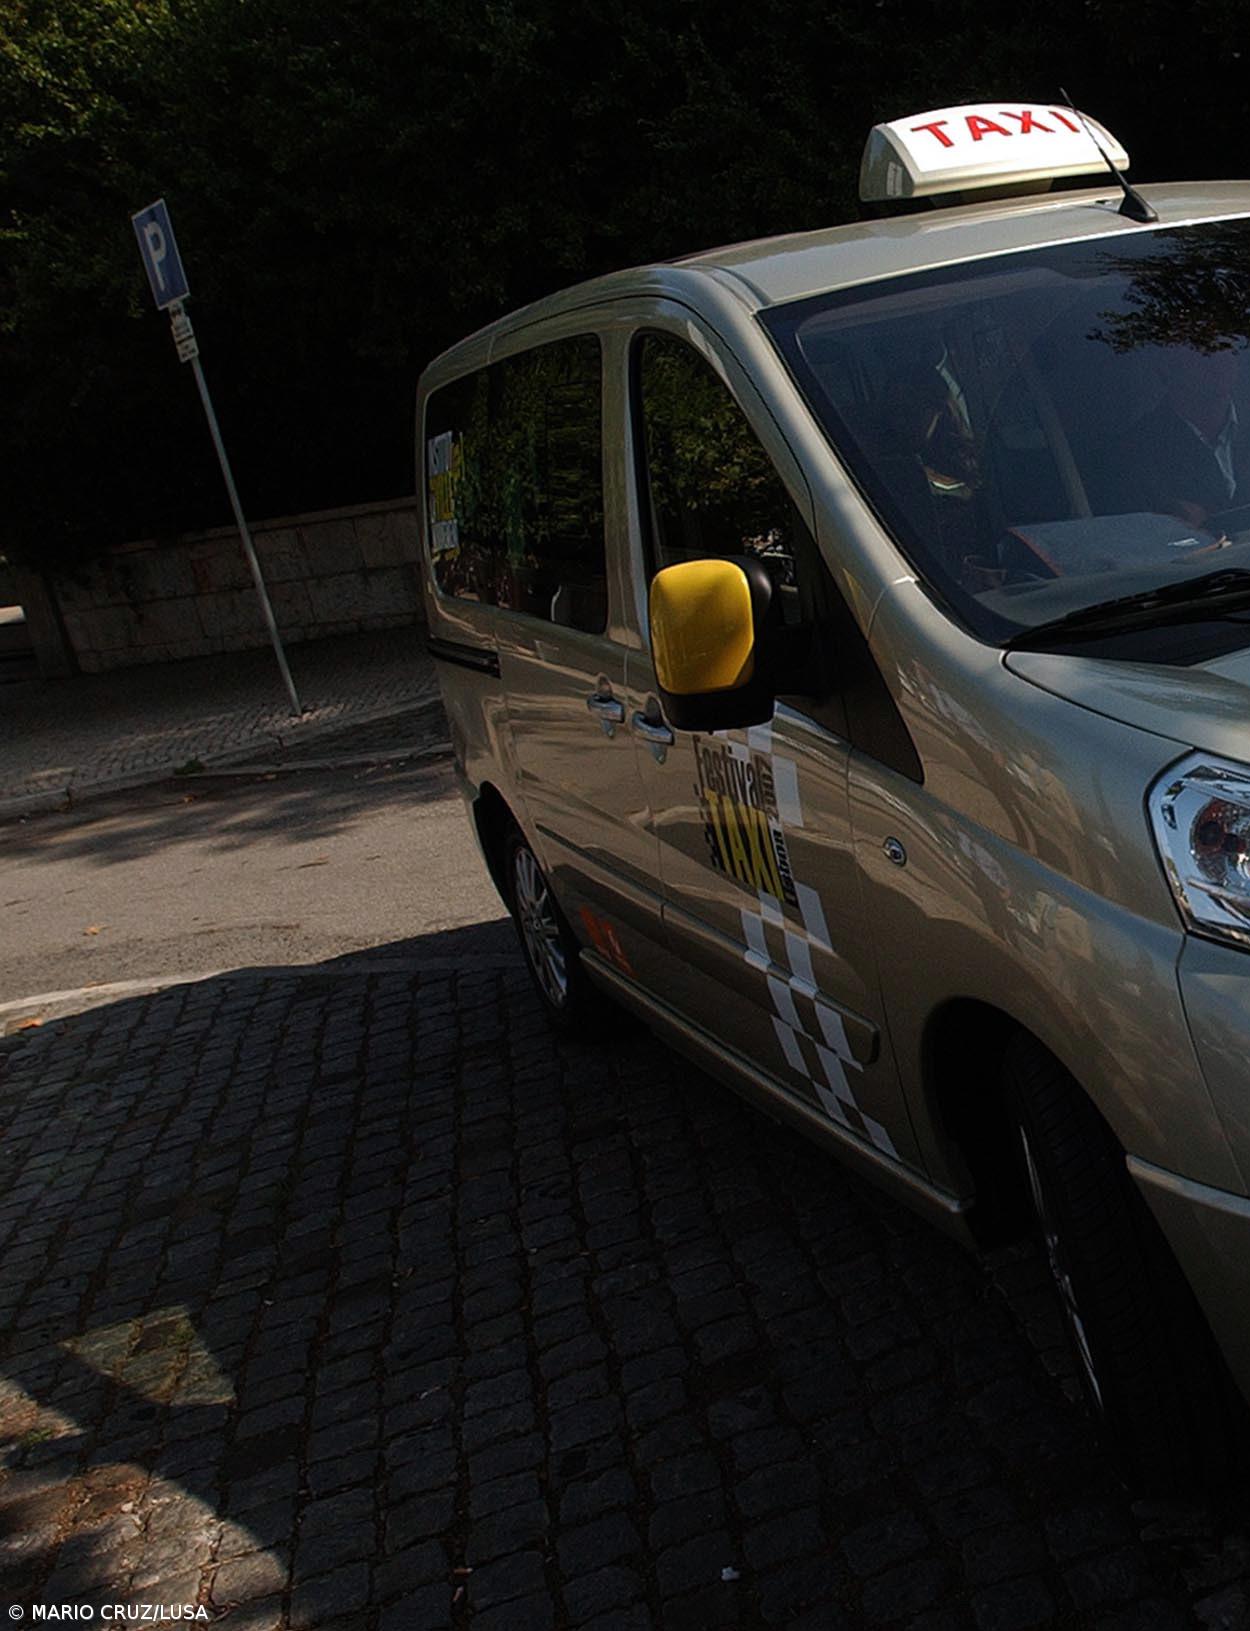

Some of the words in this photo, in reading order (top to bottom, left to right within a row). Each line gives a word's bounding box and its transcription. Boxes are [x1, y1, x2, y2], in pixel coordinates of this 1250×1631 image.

[911, 110, 1081, 148] TAXI
[143, 220, 166, 292] P
[703, 786, 786, 902] TAXI
